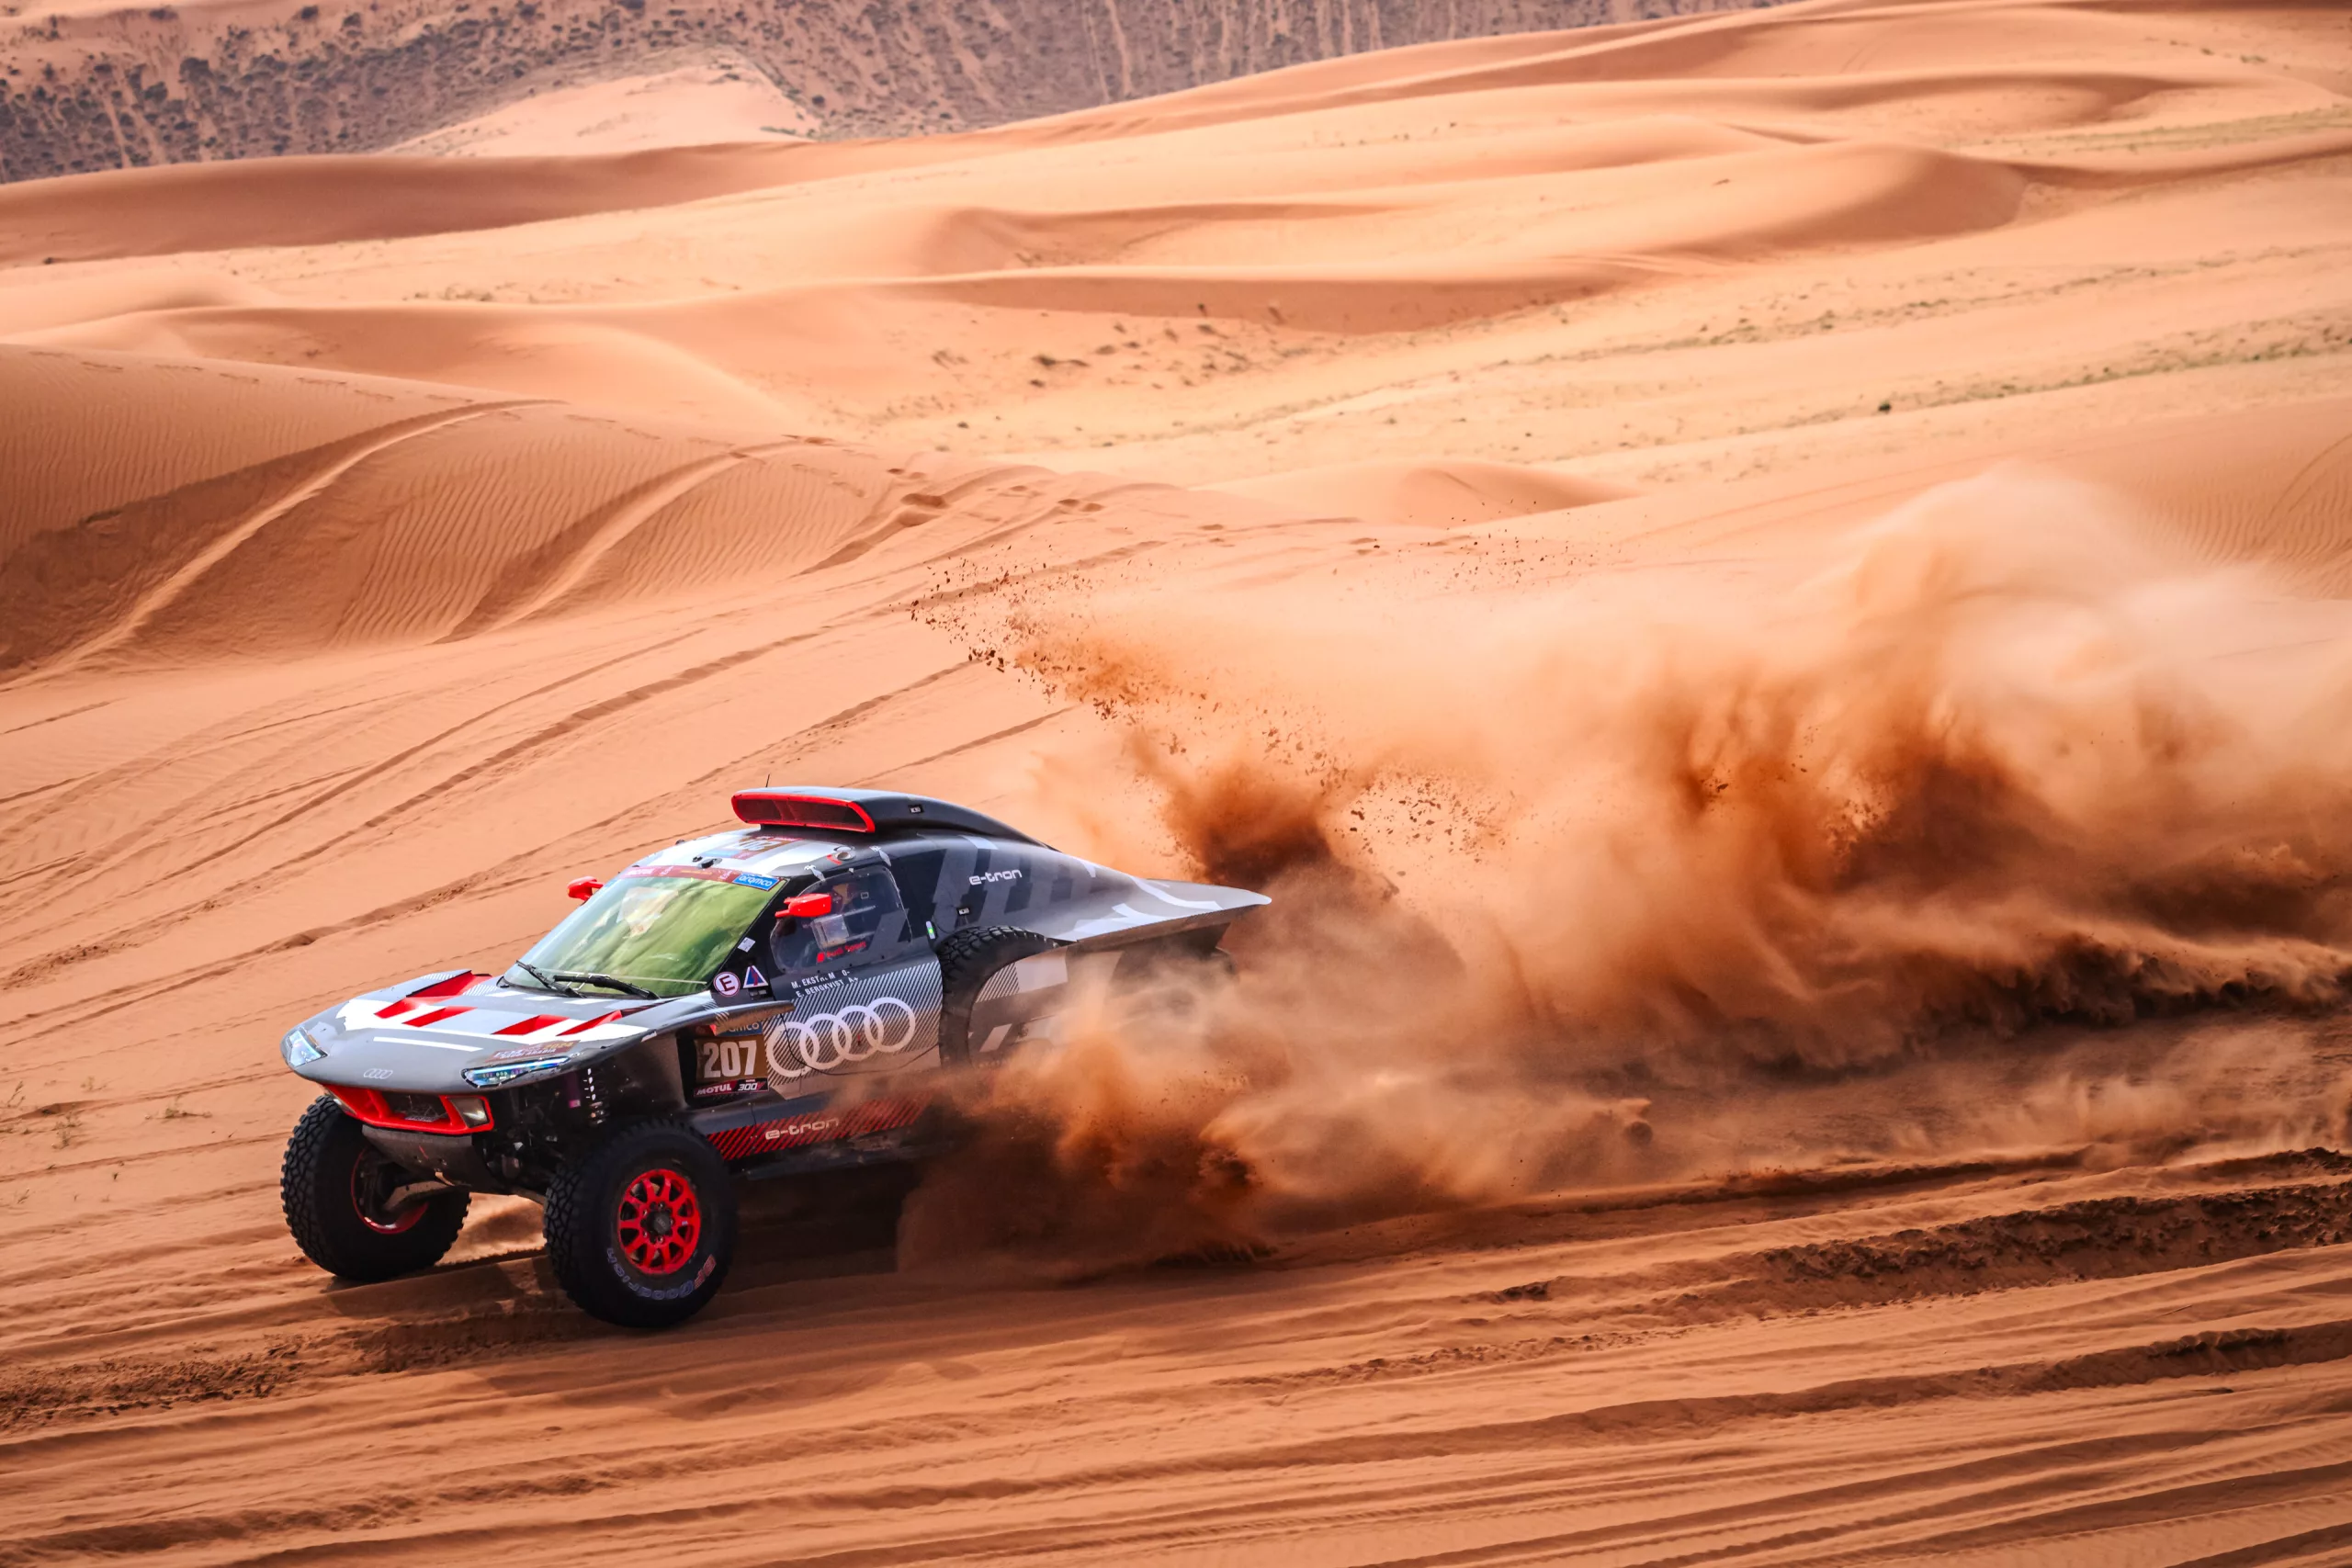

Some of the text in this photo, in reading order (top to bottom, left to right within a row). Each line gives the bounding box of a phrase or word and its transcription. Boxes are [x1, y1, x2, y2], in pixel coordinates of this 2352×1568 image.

[739, 874, 773, 887] aramco
[968, 869, 1023, 886] e-tron
[718, 975, 736, 992] E
[801, 972, 836, 987] EKSTM
[805, 979, 844, 995] BERGKVIST
[703, 1040, 757, 1078] 207
[696, 1083, 732, 1095] MOTUL
[765, 1118, 840, 1140] e-tron
